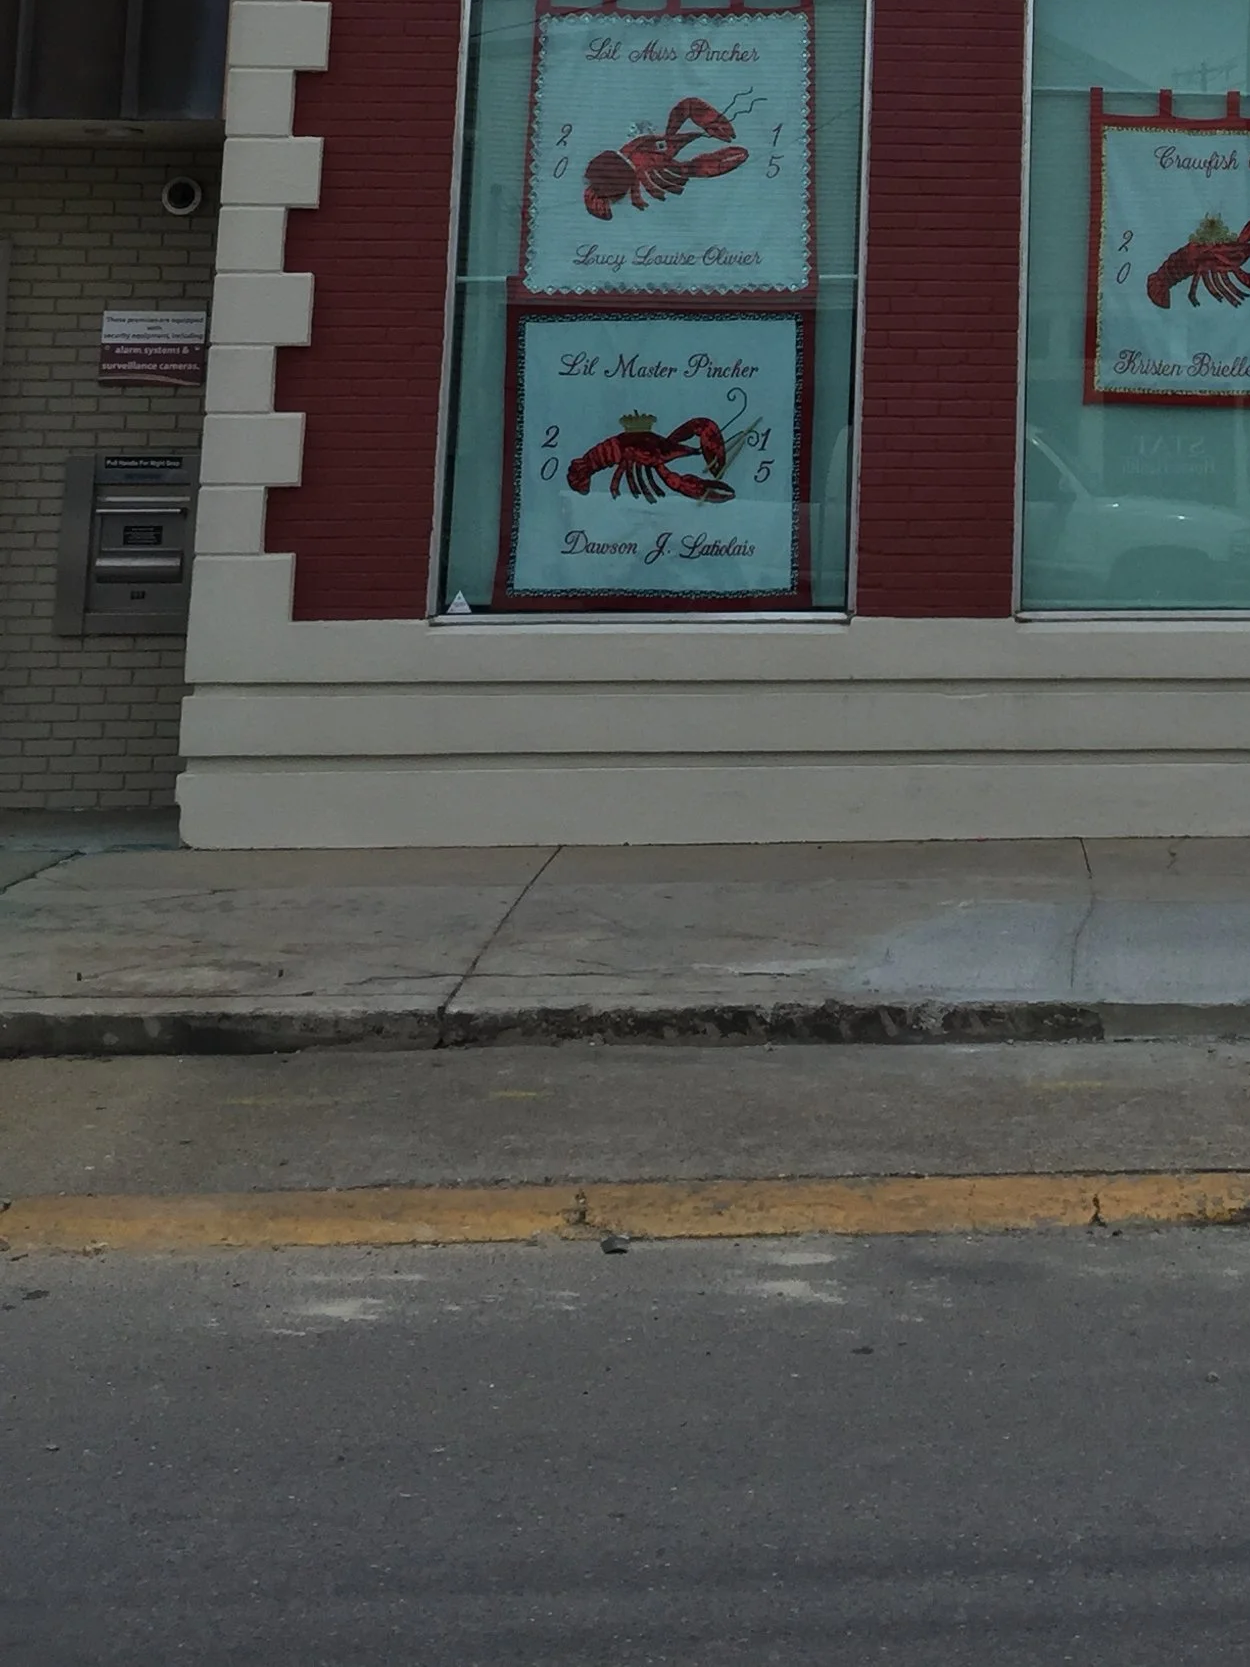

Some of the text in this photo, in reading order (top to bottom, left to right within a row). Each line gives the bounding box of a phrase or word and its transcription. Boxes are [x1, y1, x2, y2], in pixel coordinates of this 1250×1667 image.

[585, 37, 760, 63] Lil Miss Pincher
[1154, 145, 1241, 179] Crawfish
[573, 244, 764, 273] Lucy Louise Olivier
[114, 345, 190, 356] alarm systems &
[1113, 349, 1184, 376] Kristen
[102, 361, 158, 370] surveillance
[558, 351, 760, 379] Lil Master Pincher
[560, 530, 639, 555] Dawson
[644, 532, 673, 565] J.
